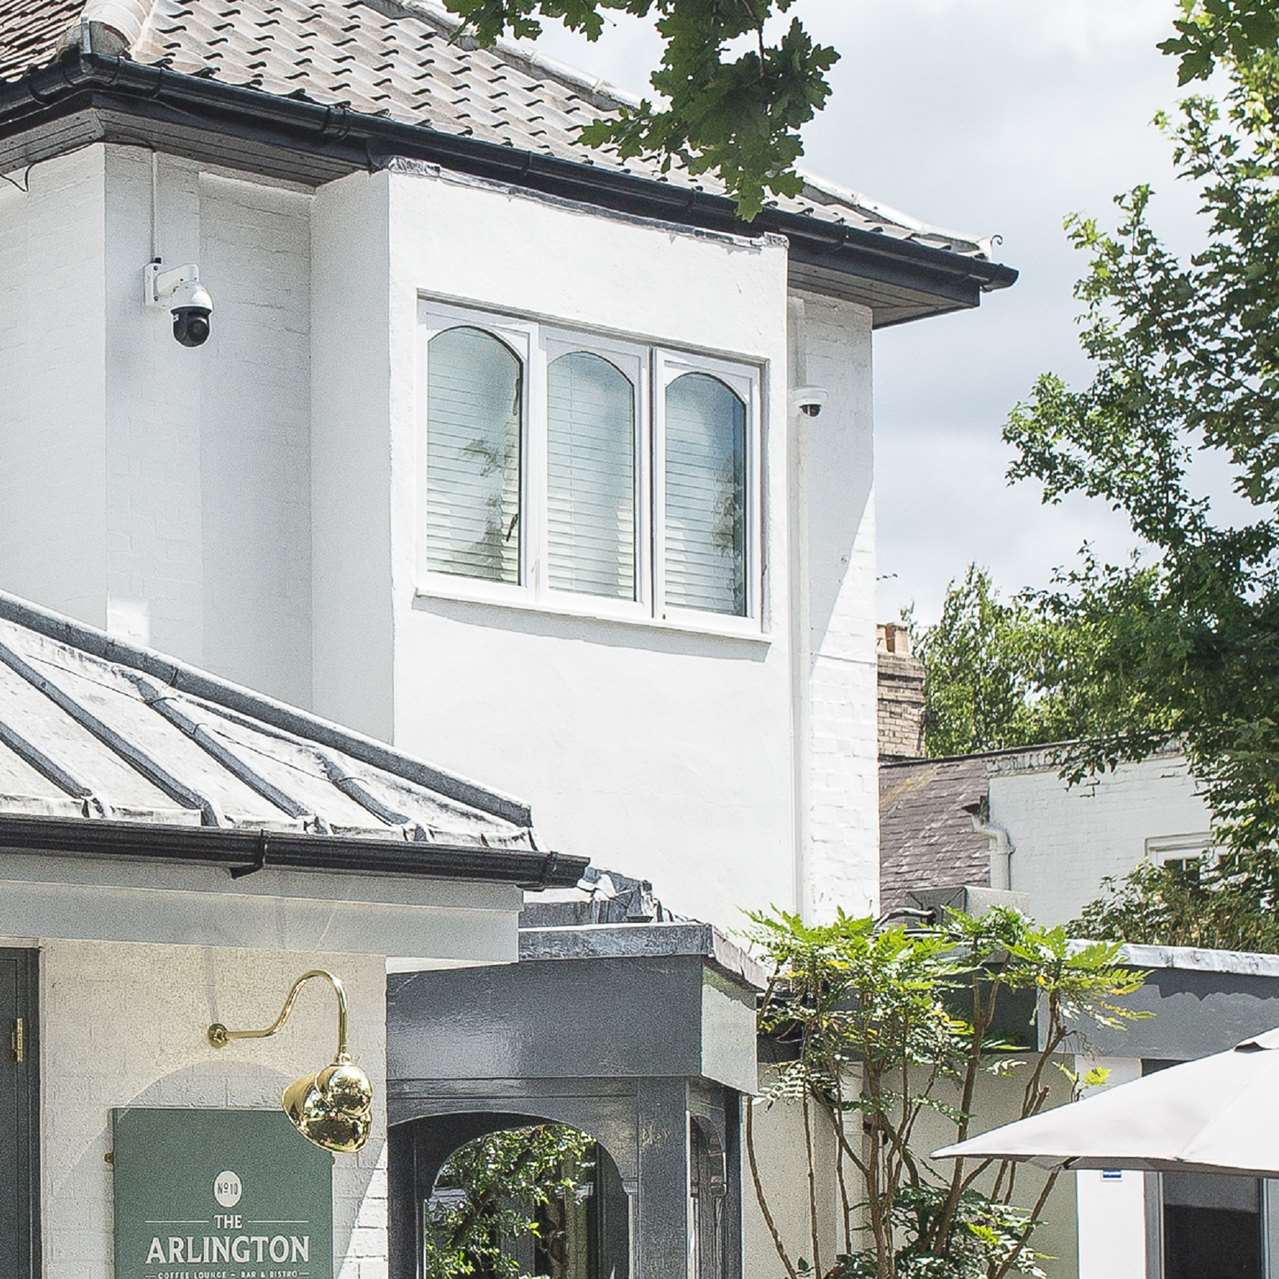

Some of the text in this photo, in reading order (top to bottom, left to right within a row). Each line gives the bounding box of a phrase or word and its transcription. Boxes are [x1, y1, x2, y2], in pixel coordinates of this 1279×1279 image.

[214, 1214, 243, 1229] THE
[144, 1235, 310, 1264] ARLINGTON
[157, 1271, 190, 1279] COFFEE
[193, 1271, 227, 1279] LOUNGE
[240, 1271, 257, 1279] BAR
[269, 1270, 298, 1279] BISTRO
